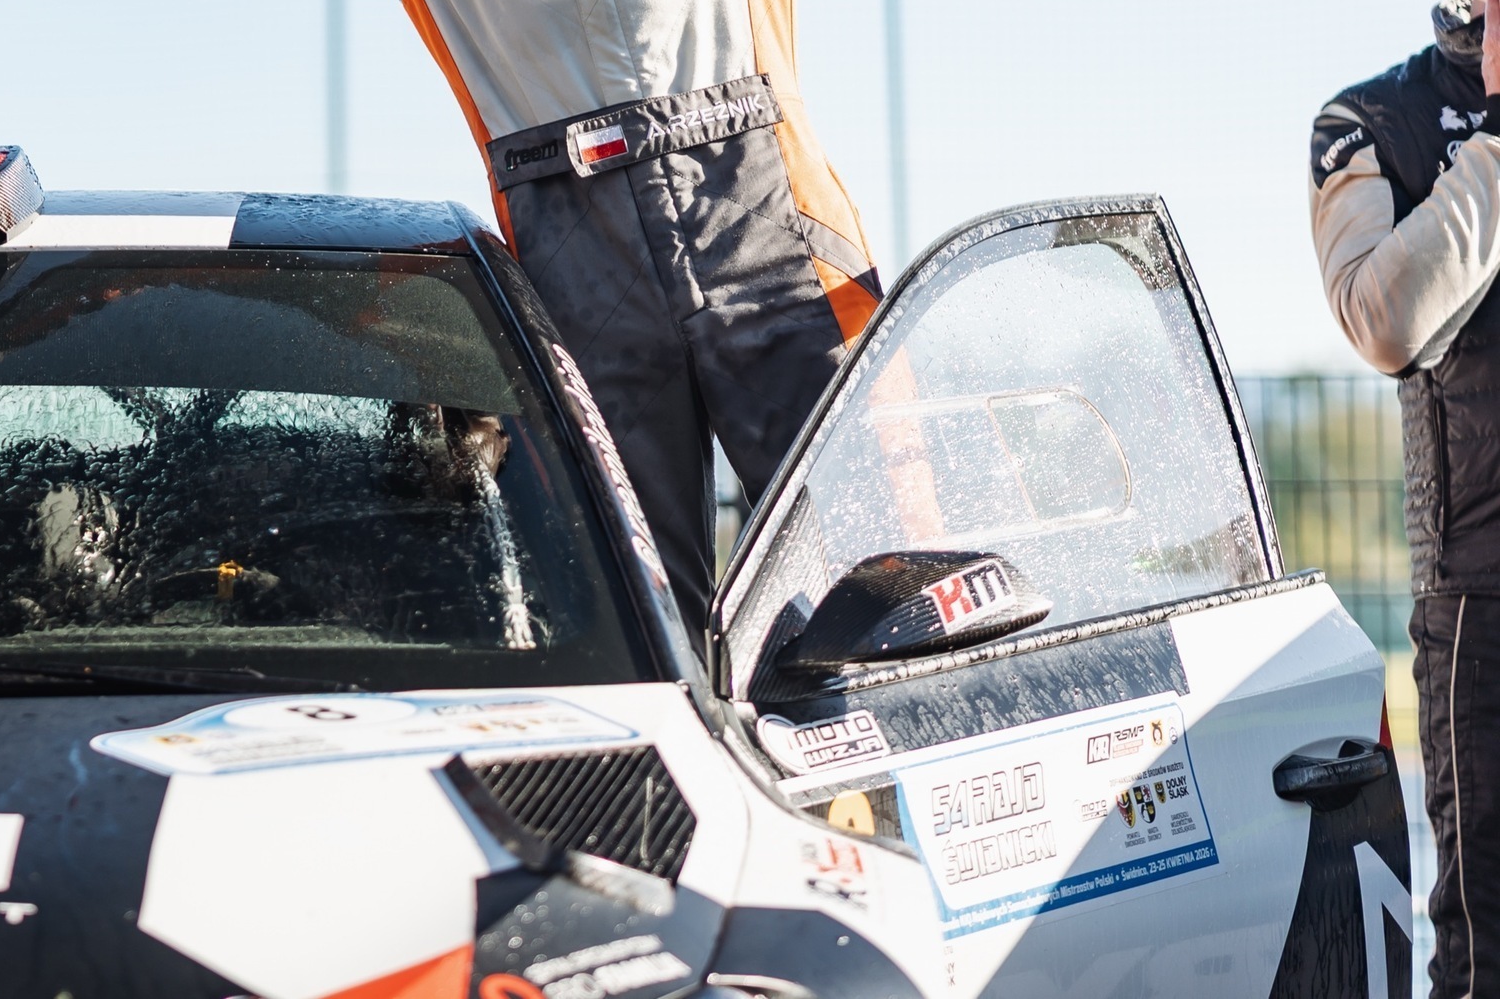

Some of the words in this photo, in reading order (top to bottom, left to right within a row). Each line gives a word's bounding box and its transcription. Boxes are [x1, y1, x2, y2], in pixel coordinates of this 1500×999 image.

[1320, 126, 1364, 172] freem
[803, 734, 885, 769] WIZJA
[931, 779, 970, 837] 54
[971, 760, 1046, 827] RAJD
[1166, 775, 1187, 789] DOLNY
[1168, 786, 1189, 800] ŚLĄSK
[1094, 872, 1115, 889] Polski
[1166, 851, 1194, 868] KWIETNIA
